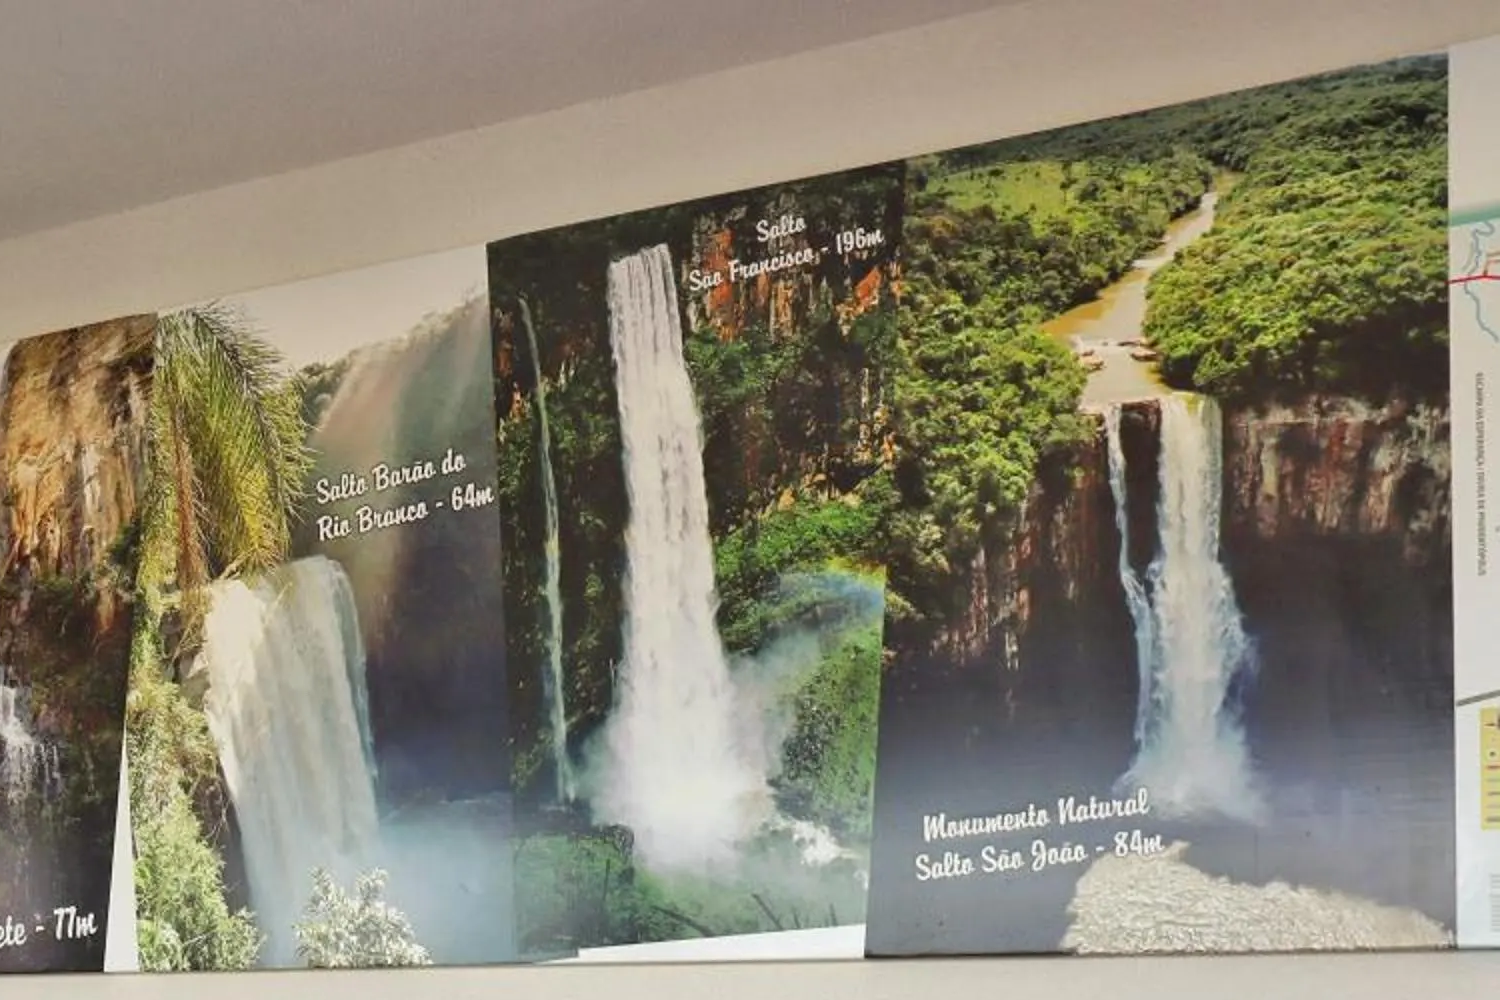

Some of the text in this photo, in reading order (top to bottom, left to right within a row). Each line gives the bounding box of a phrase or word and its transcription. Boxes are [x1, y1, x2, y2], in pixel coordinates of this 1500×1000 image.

[756, 215, 806, 242] Salto
[689, 269, 723, 291] São
[728, 248, 815, 282] Francisco
[835, 228, 884, 254] 196m
[316, 448, 466, 503] Salto Barão do
[317, 515, 352, 541] Rio
[356, 501, 428, 532] Branco
[451, 482, 495, 511] 64m
[923, 788, 1150, 842] Monumento Natural
[916, 852, 975, 880] Salto
[981, 845, 1025, 873] São
[1031, 839, 1088, 871] João
[1114, 829, 1166, 857] 84m
[53, 905, 98, 940] 77m
